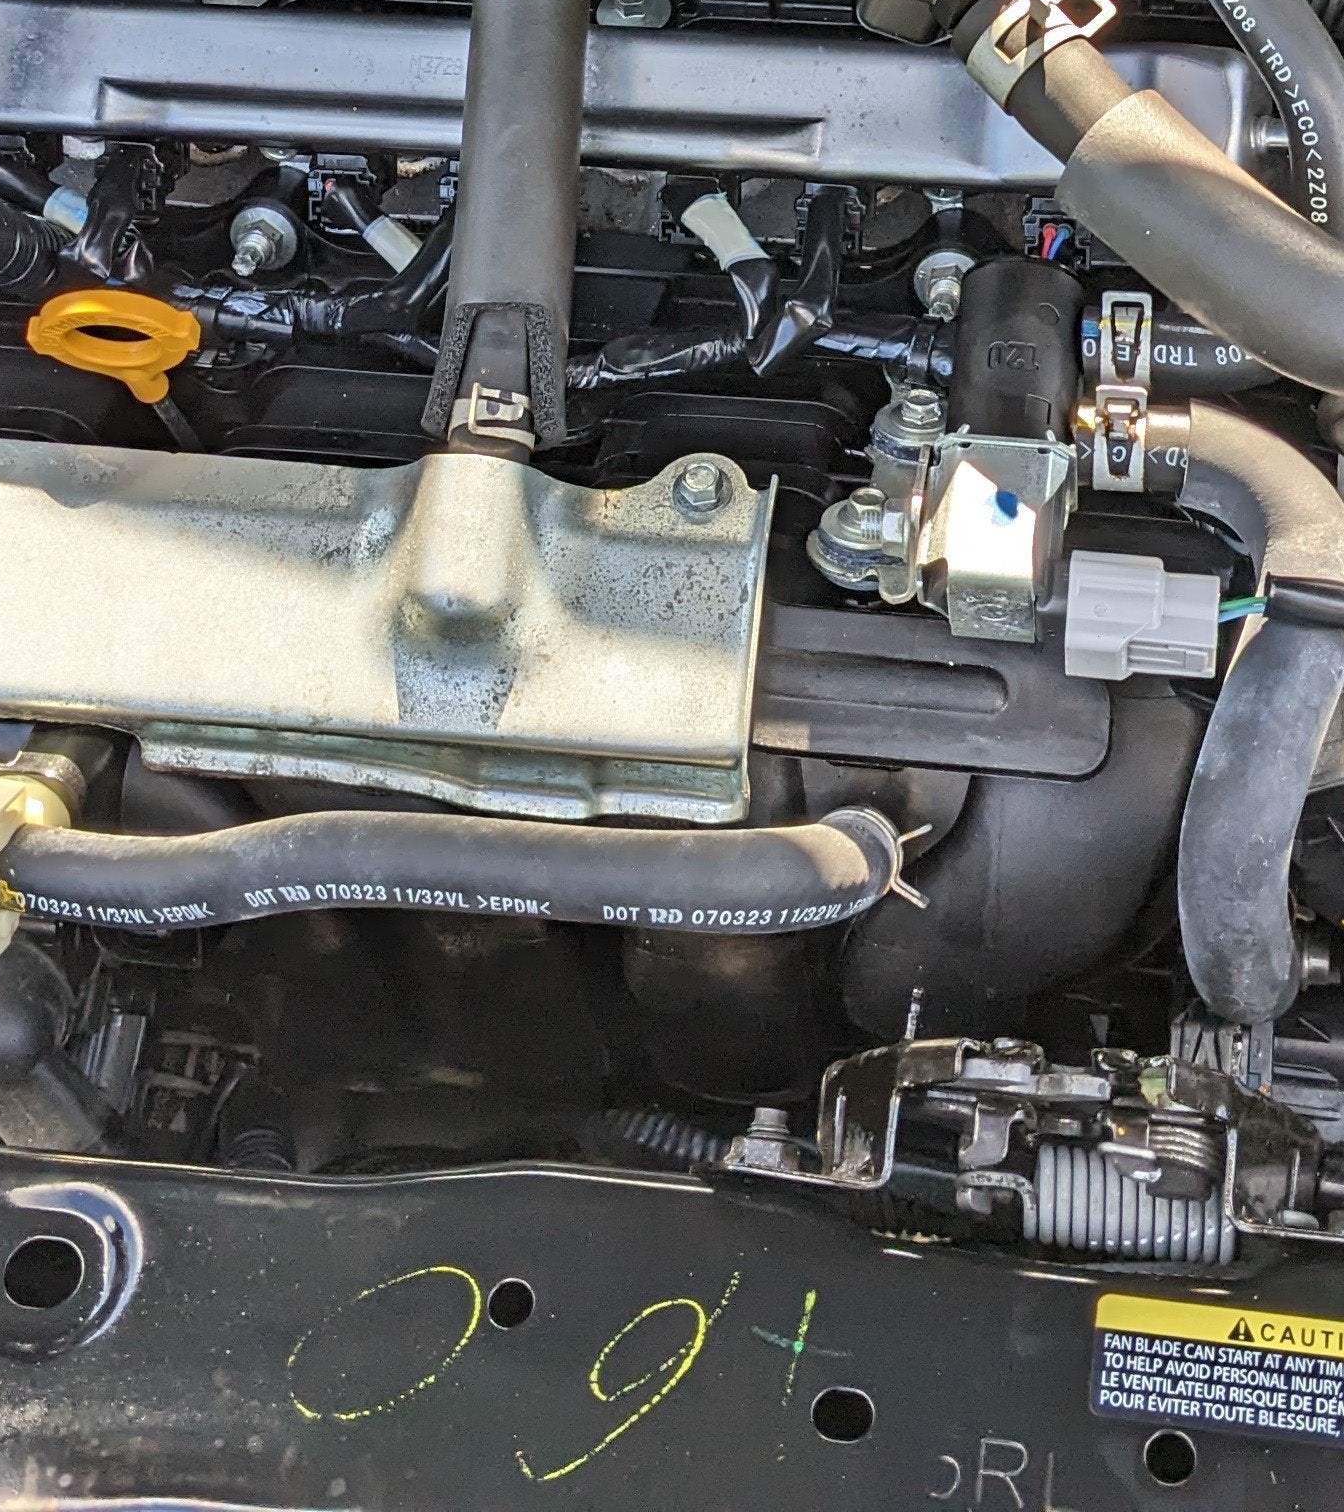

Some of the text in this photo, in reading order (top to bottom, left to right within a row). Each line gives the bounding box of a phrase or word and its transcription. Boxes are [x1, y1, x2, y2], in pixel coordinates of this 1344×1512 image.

[13, 891, 217, 926] 070323 11/32VL >EPDM<
[243, 887, 278, 909] DOT
[314, 883, 388, 903] 070323
[392, 886, 472, 909] 11/32VL
[475, 893, 553, 917] >EPDM<
[601, 903, 642, 923] DOT
[690, 907, 773, 927] 070323
[777, 901, 843, 925] 11/32VL
[1104, 1333, 1133, 1351] FAN
[1133, 1336, 1182, 1357] BLADE
[1184, 1342, 1216, 1360] CAN
[1218, 1345, 1261, 1365] START
[1263, 1352, 1283, 1368] AT
[1284, 1355, 1316, 1372] ANY
[1101, 1370, 1120, 1387] LE
[1121, 1372, 1226, 1402] VENTILATEUR
[1228, 1383, 1289, 1411] RISQUE
[1290, 1393, 1313, 1410] DE
[1103, 1351, 1124, 1368] TO
[1126, 1354, 1163, 1374] HELP
[1164, 1359, 1212, 1380] AVOID
[1213, 1364, 1289, 1391] PERSONAL
[1290, 1374, 1344, 1400] INJURY,
[1100, 1389, 1146, 1410] POUR
[1147, 1392, 1201, 1418] ÉVITER
[1202, 1402, 1258, 1425] TOUTE
[1258, 1410, 1342, 1438] BLESSURE,
